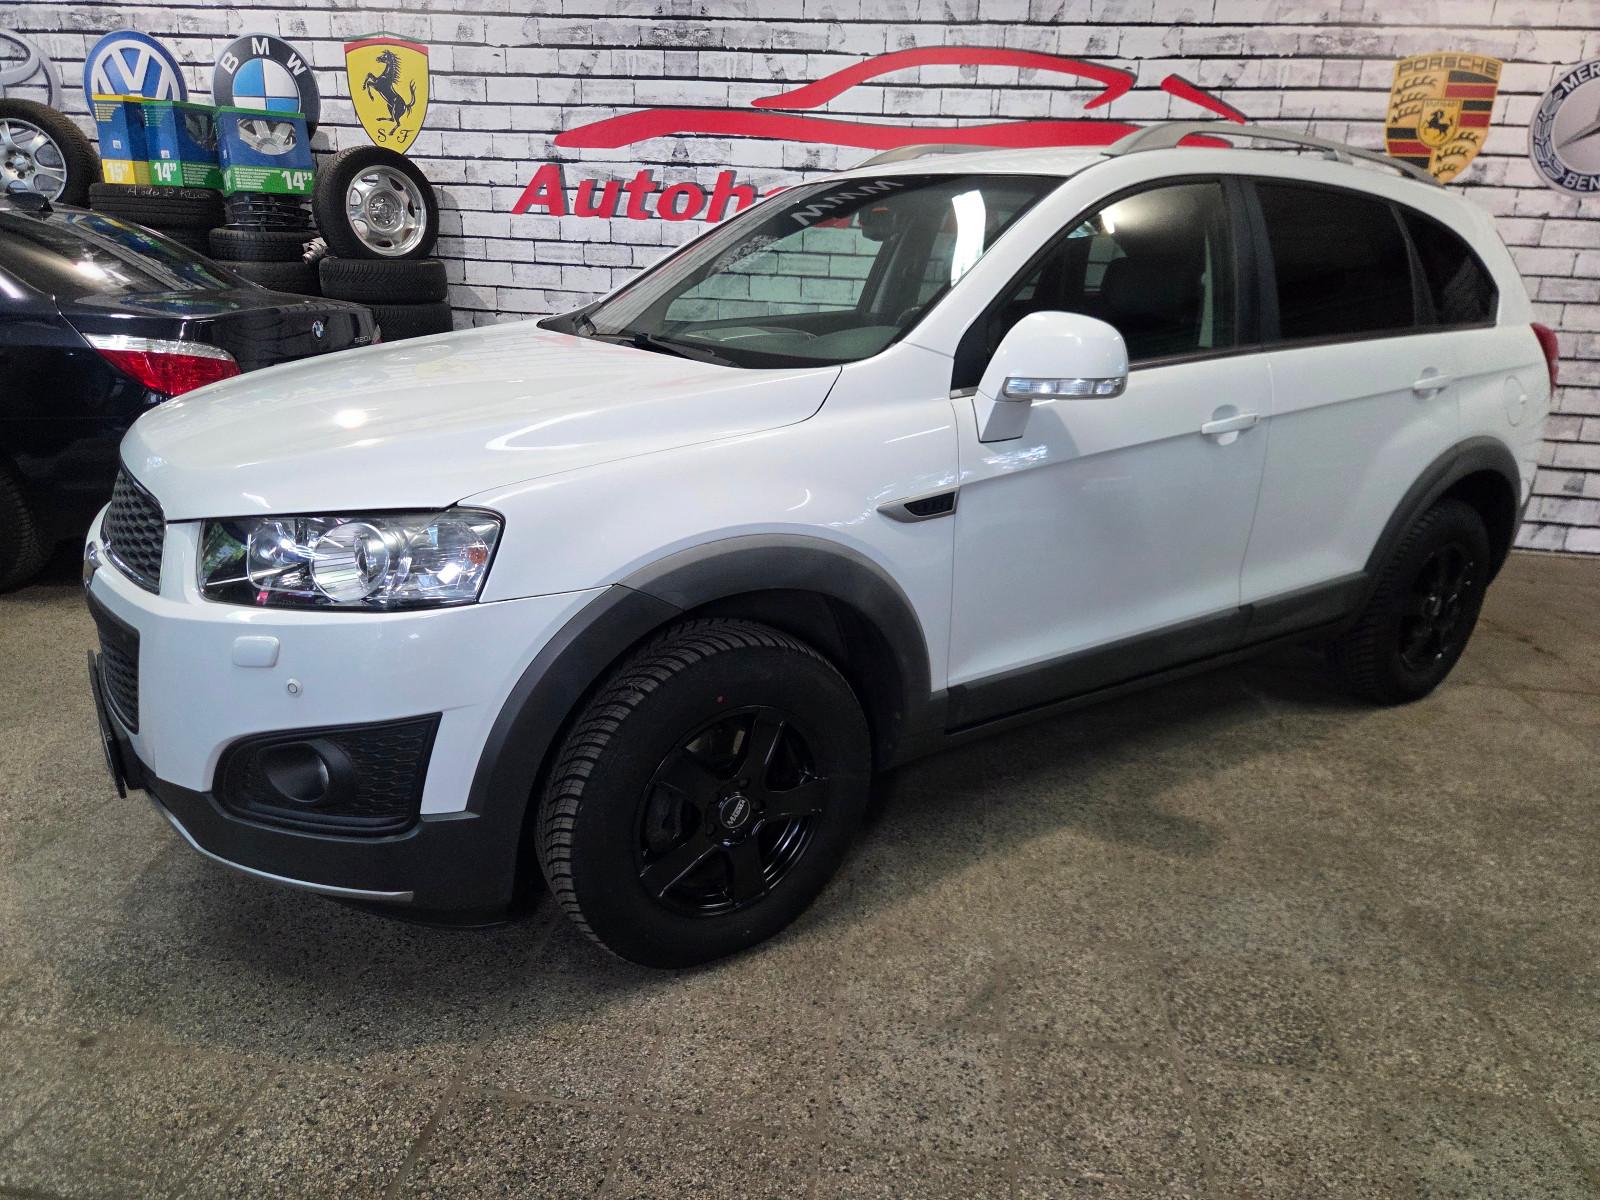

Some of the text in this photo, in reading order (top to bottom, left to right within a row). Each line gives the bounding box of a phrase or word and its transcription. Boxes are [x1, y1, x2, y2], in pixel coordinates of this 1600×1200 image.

[220, 37, 307, 77] BMW
[1400, 56, 1500, 78] PORSCHE
[511, 163, 792, 224] Autoh
